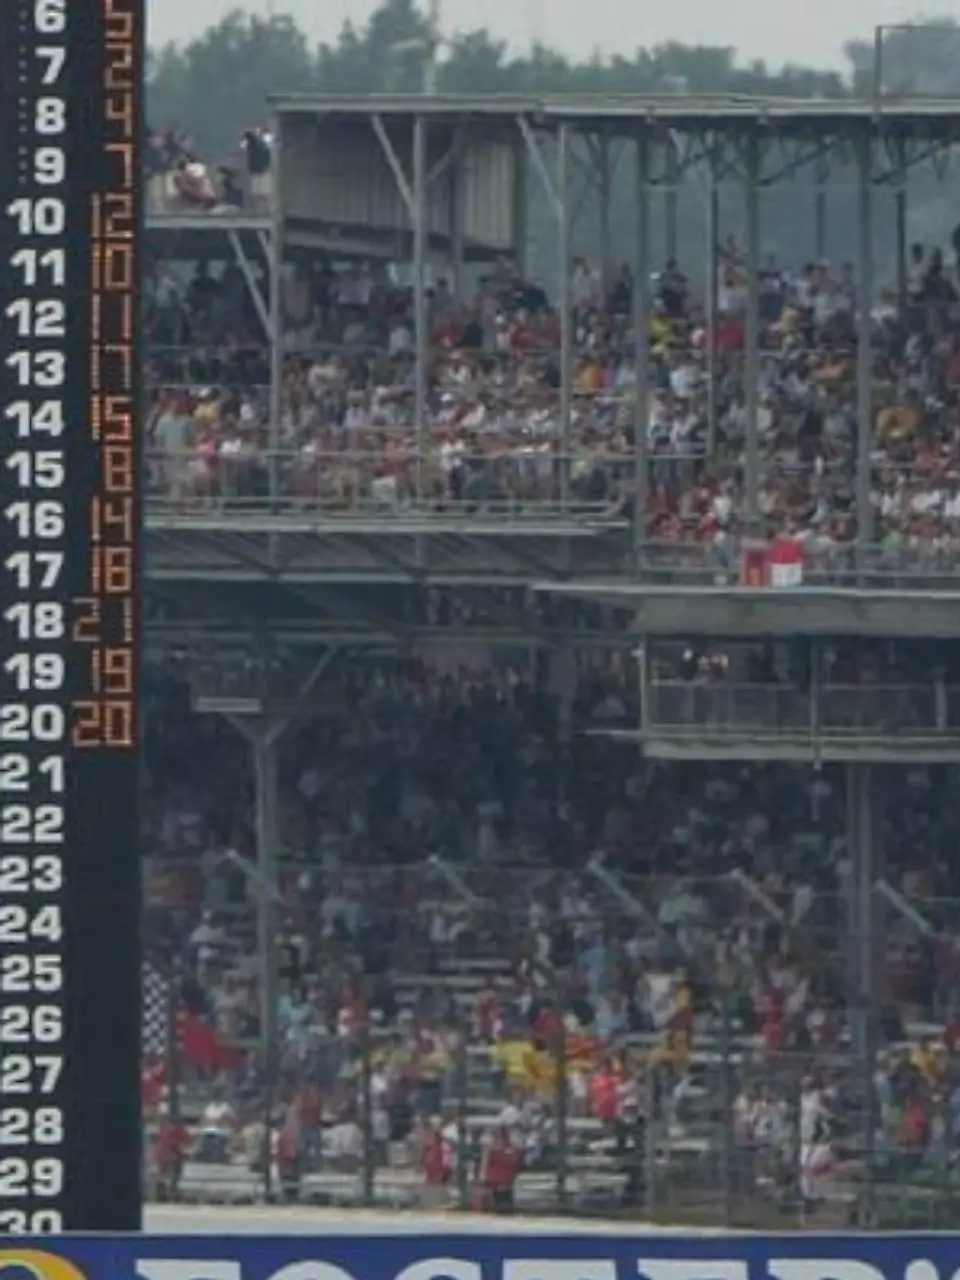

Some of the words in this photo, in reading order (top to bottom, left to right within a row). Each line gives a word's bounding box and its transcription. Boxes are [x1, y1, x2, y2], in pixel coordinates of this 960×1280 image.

[34, 0, 66, 33] 6
[34, 46, 66, 85] 7
[34, 97, 66, 135] 8
[34, 146, 65, 184] 9
[6, 197, 65, 235] 10
[9, 248, 65, 286] 11
[5, 298, 65, 337] 12
[5, 350, 65, 386] 13
[4, 400, 65, 437] 14
[5, 450, 65, 488] 15
[4, 501, 65, 538] 16
[4, 551, 64, 588] 17
[3, 601, 65, 640] 18
[4, 653, 65, 691] 19
[0, 703, 65, 741] 20
[0, 753, 64, 792] 21
[1, 805, 64, 843] 22
[0, 855, 62, 892] 23
[0, 905, 62, 942] 24
[1, 954, 62, 992] 25
[1, 1005, 62, 1042] 26
[1, 1054, 63, 1093] 27
[0, 1107, 63, 1145] 28
[0, 1157, 63, 1196] 29
